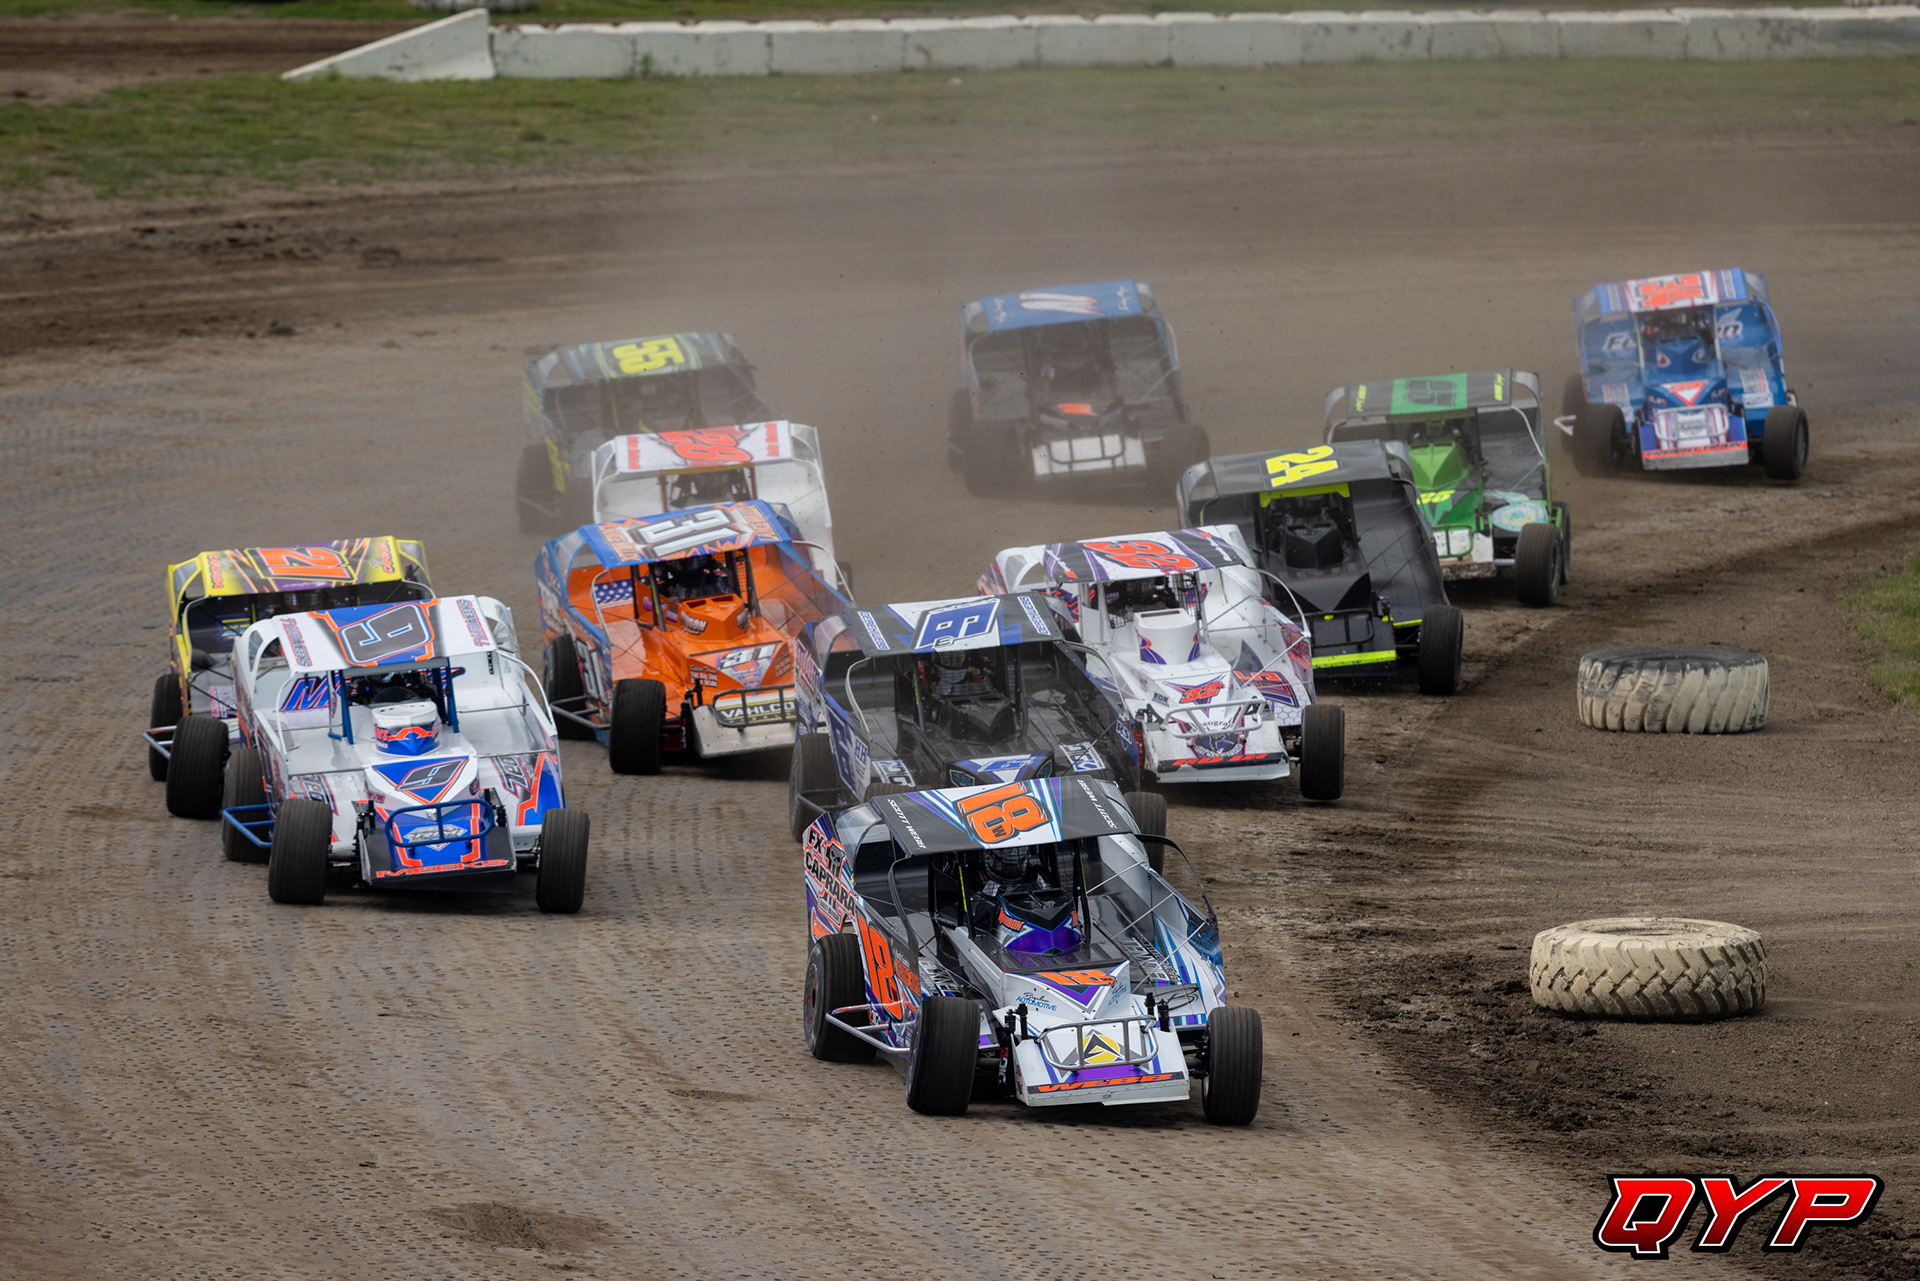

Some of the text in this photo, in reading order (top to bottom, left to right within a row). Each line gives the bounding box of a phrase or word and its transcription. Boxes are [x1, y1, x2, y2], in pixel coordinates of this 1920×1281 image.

[613, 337, 686, 374] 55
[659, 430, 751, 462] 28
[1266, 446, 1339, 487] 24
[641, 508, 738, 559] 31
[257, 548, 350, 578] 21
[1083, 541, 1199, 569] 32
[340, 603, 430, 665] 9
[723, 643, 778, 669] 31
[1179, 682, 1223, 703] 32
[720, 701, 796, 719] VAHLCO
[400, 759, 465, 789] 9
[1076, 778, 1098, 803] WEBB
[887, 799, 910, 824] SCOTT
[906, 823, 926, 849] WEBB
[956, 782, 1048, 844] 18
[1094, 803, 1118, 830] SCOTT
[376, 860, 509, 878] MEEKS
[804, 850, 857, 919] CAPRARA
[857, 912, 903, 1020] 18
[1035, 969, 1110, 987] 18
[1016, 995, 1057, 1012] AUTOMOTIVE
[1038, 1073, 1173, 1093] WEBB
